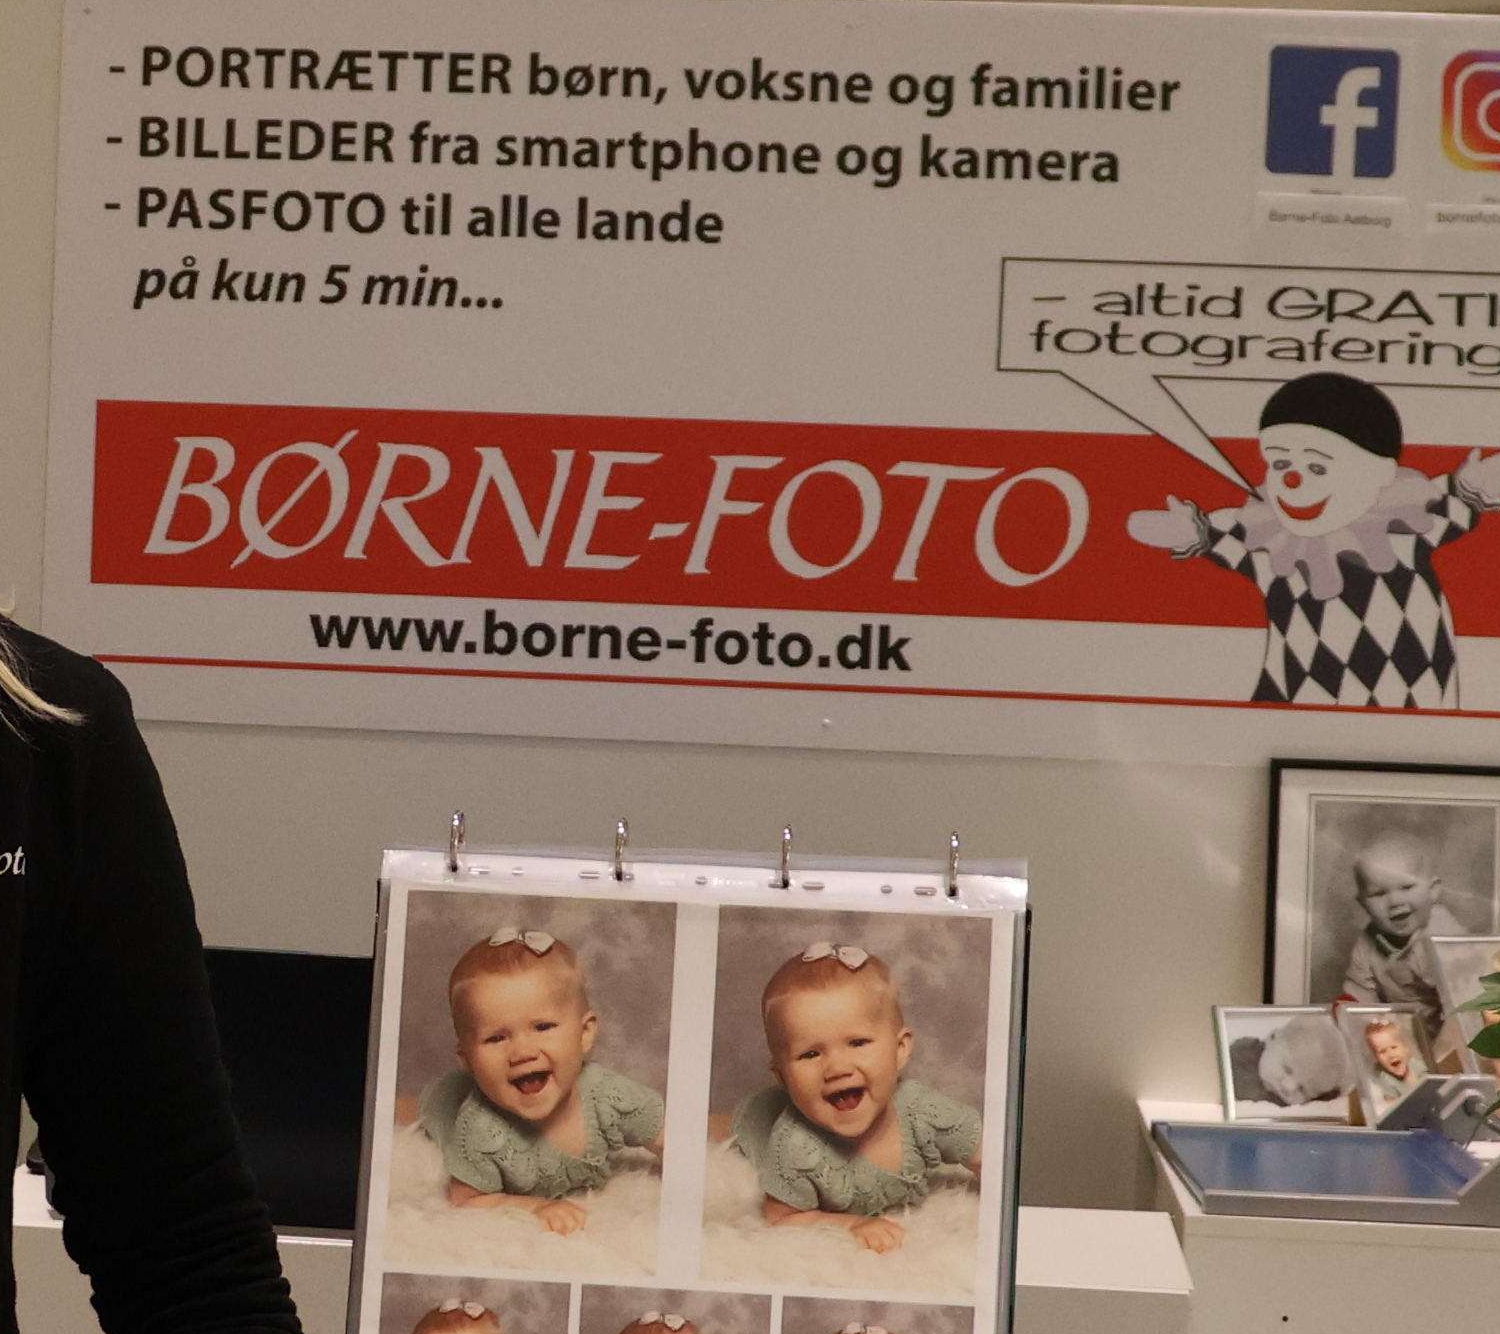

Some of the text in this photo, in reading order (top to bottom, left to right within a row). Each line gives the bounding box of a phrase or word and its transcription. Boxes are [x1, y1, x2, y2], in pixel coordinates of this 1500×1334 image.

[142, 45, 512, 96] PORTRÆTTER
[529, 51, 668, 105] børn,
[684, 57, 873, 105] voksne
[888, 70, 955, 117] og
[970, 63, 1181, 112] familier
[139, 115, 395, 163] BILLEDER
[409, 121, 479, 166] fra
[496, 128, 821, 181] smartphone
[836, 145, 903, 188] og
[919, 134, 1120, 183] kamera
[137, 187, 386, 234] PASFOTO
[401, 192, 452, 236] til
[467, 194, 561, 240] alle
[577, 197, 724, 243] lande
[133, 255, 504, 309] på kun 5 min...
[1092, 282, 1244, 319] altid
[143, 428, 1091, 587] BØRNE-FOTO
[308, 608, 914, 673] www.borne-foto.dk
